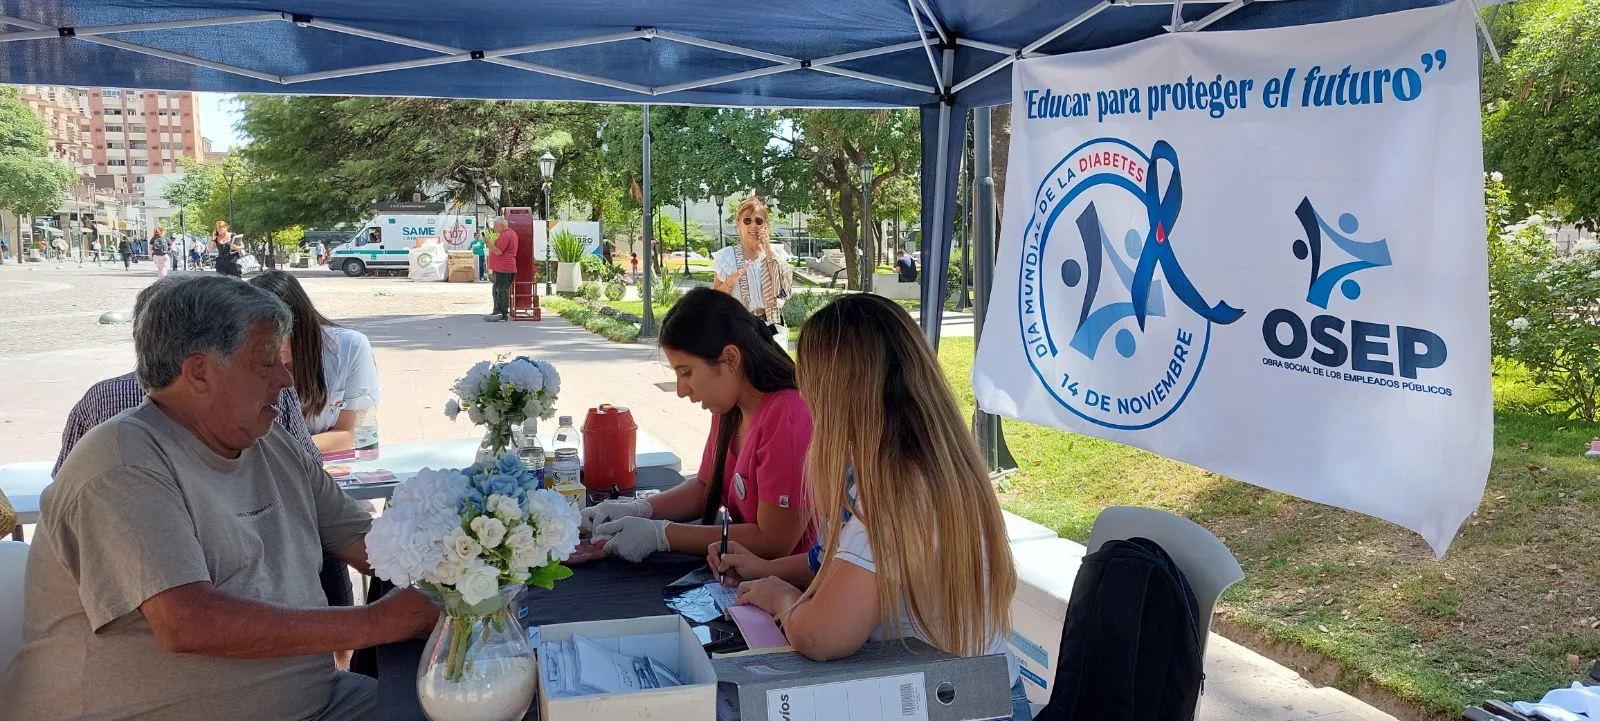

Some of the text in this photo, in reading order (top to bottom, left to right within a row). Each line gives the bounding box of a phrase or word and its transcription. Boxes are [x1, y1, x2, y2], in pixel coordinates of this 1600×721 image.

[1096, 86, 1141, 122] para
[1148, 74, 1253, 120] proteger
[1262, 67, 1296, 109] el
[402, 226, 435, 236] SAME
[448, 229, 463, 239] 107
[1024, 151, 1144, 358] DÍA MUNDIAL DE LA DIABETES
[1060, 328, 1193, 415] 14 DE NOVIEMBRE
[1262, 308, 1448, 380] OSEP
[1262, 357, 1452, 397] OBRA SOCIAL DE LOS EMPLEADOS PÚBLICOS
